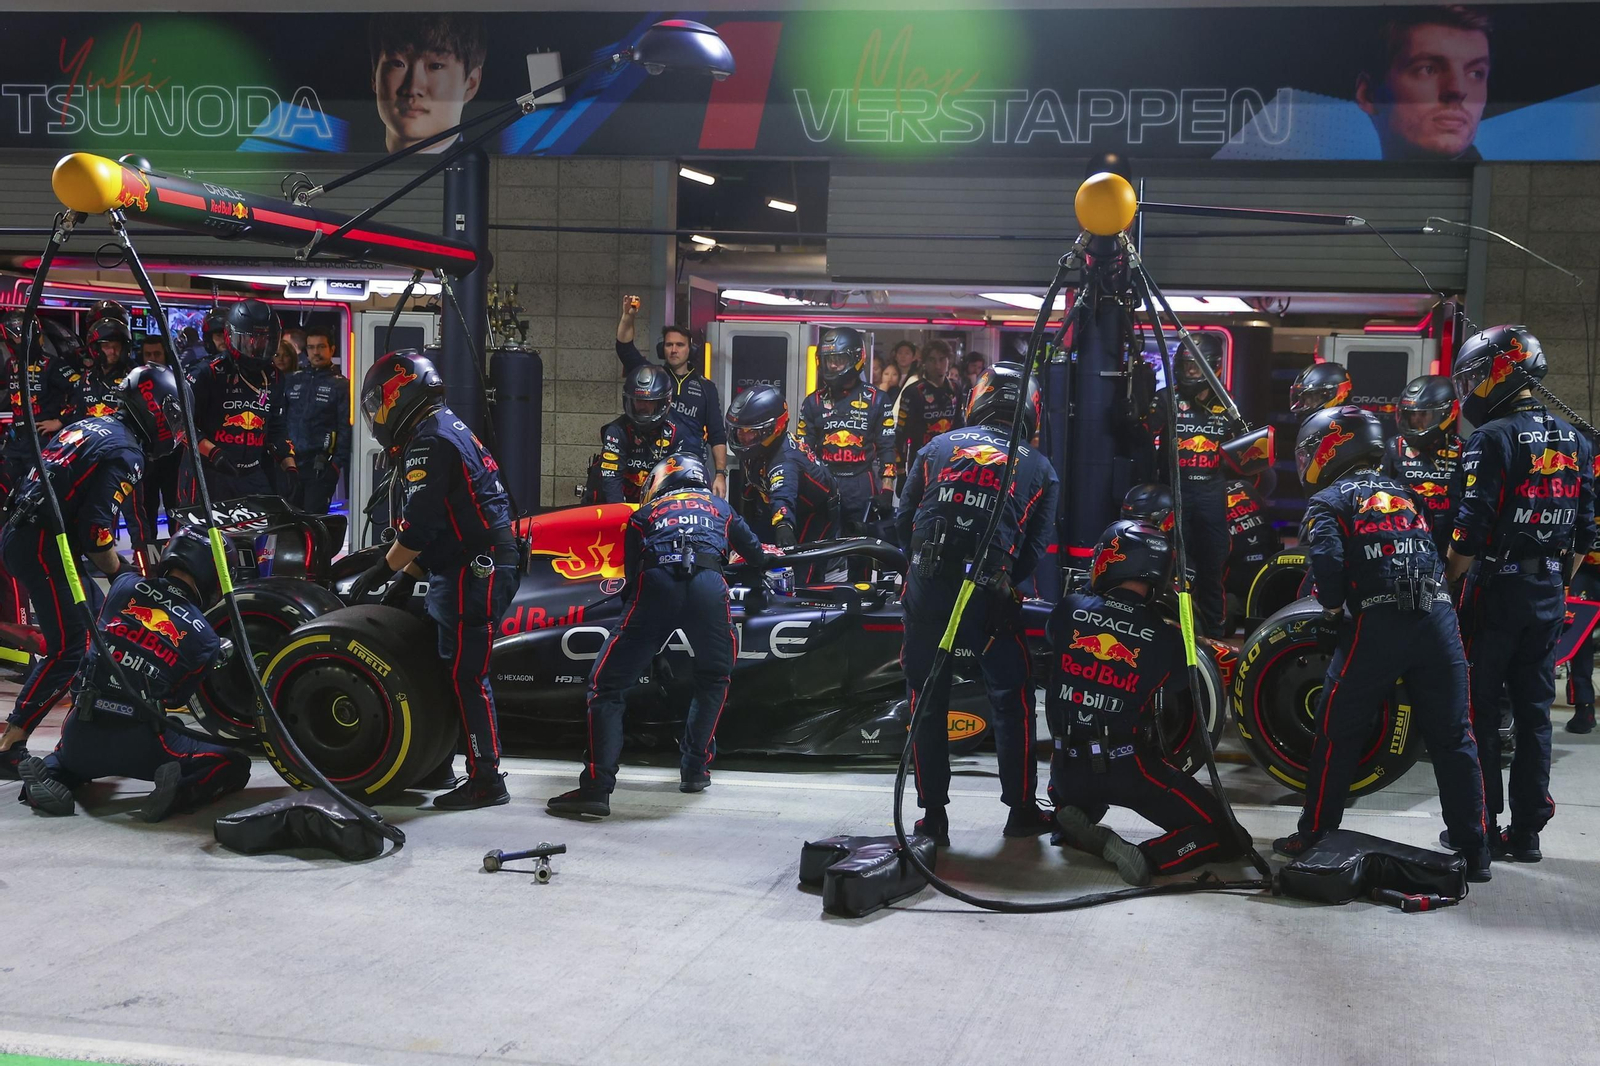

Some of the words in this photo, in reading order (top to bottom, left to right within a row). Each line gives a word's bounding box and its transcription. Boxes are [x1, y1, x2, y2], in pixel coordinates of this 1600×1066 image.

[58, 22, 171, 127] Yuki
[852, 24, 982, 111] Max
[2, 84, 332, 138] TSUNODA
[792, 87, 1293, 144] VERSTAPPEN
[202, 182, 246, 202] ORACLE
[330, 281, 362, 290] ORACLE
[9, 382, 42, 391] ORLE
[737, 378, 781, 388] ORACLE
[214, 429, 245, 445] Red
[1518, 429, 1576, 444] ORACLE
[1405, 470, 1451, 480] ORACLE
[938, 486, 987, 509] Mobil
[654, 514, 698, 531] Mobil
[1513, 507, 1562, 525] Mobil
[1363, 537, 1413, 560] Mobil
[135, 581, 206, 633] ORACLE
[1072, 609, 1156, 642] ORACLE
[104, 616, 144, 644] Red
[141, 630, 180, 668] Bull
[560, 620, 812, 661] OALE
[347, 639, 392, 678] PIRELLI
[504, 673, 534, 682] HEXAGON
[1061, 652, 1098, 681] Red
[1097, 662, 1141, 694] Bull
[1233, 641, 1262, 718] ZERO
[94, 699, 134, 715] sparco
[1058, 682, 1106, 710] Mobil
[1237, 722, 1253, 740] P
[1389, 704, 1412, 755] PIRELLI
